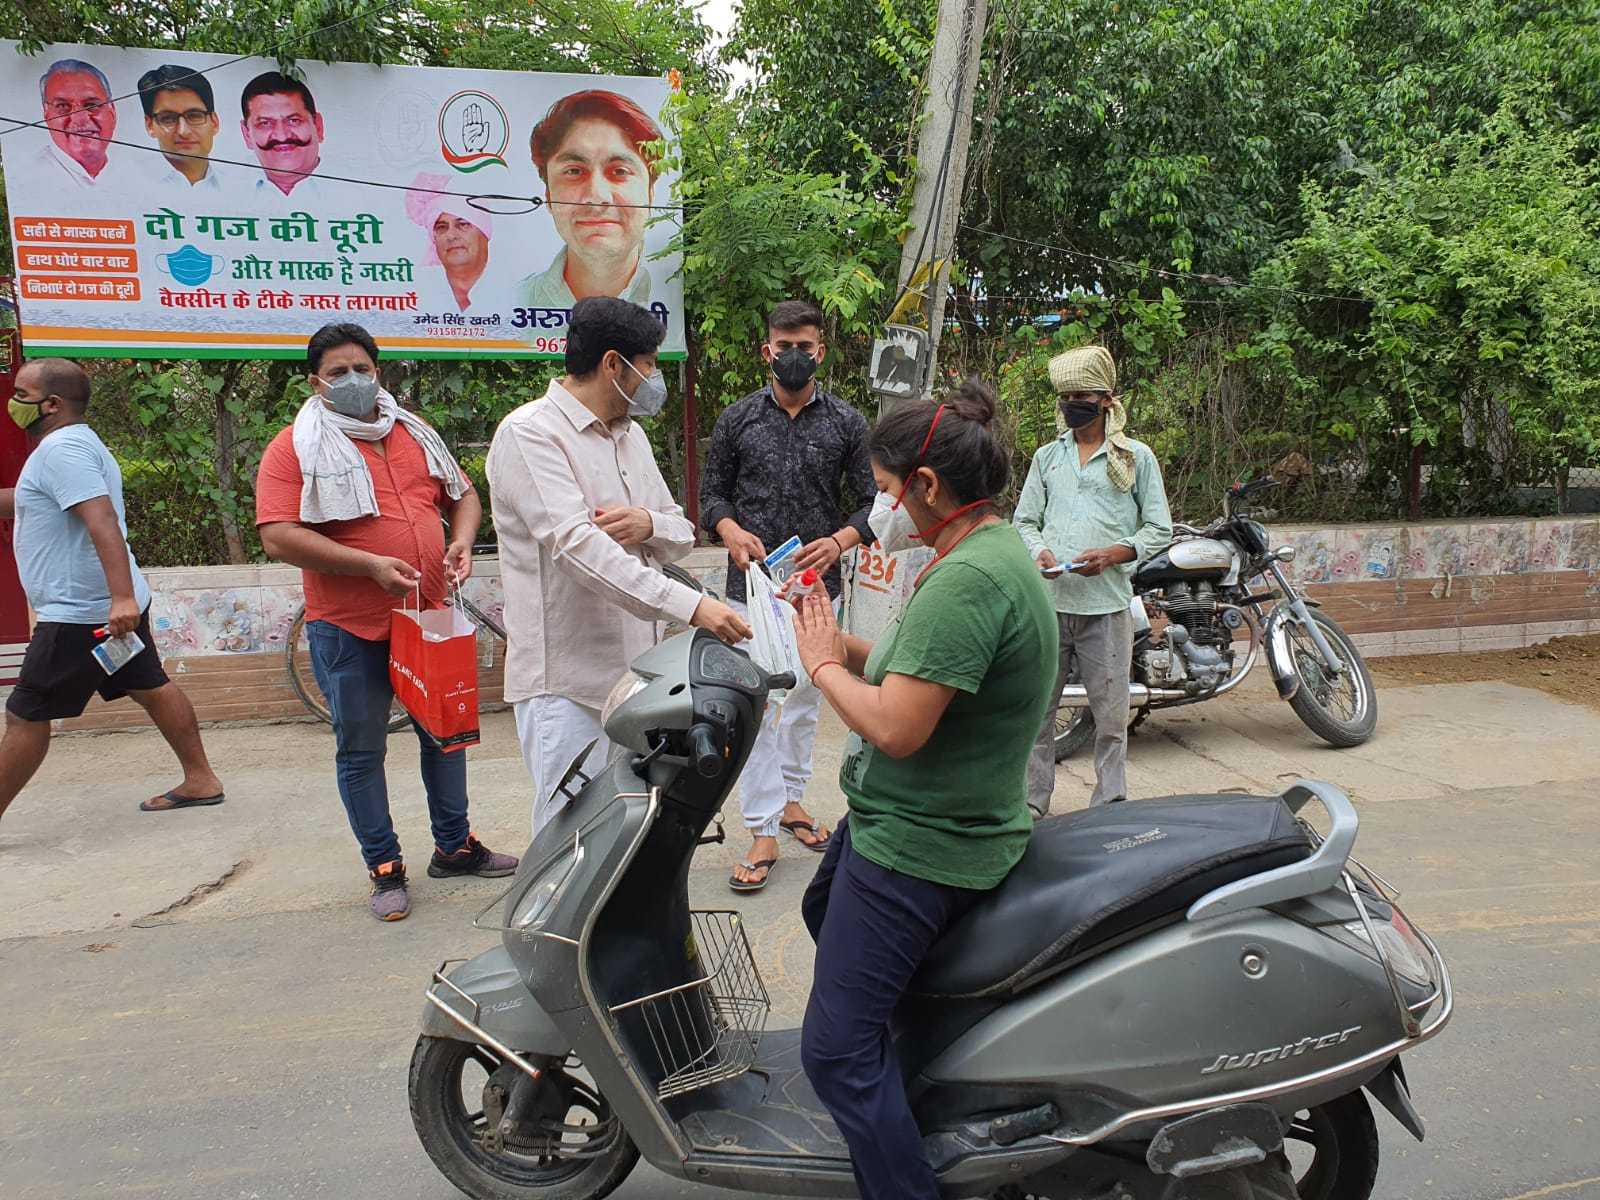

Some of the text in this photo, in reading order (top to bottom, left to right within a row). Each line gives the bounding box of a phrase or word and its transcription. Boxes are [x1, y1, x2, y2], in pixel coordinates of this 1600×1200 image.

[21, 222, 46, 238] सही
[48, 223, 61, 238] से
[63, 226, 97, 239] मास्क
[143, 207, 384, 253] दो गज की दूरी
[25, 253, 52, 266] हाथ
[231, 254, 272, 280] और
[278, 260, 334, 281] मास्क
[338, 256, 354, 285] है
[65, 280, 77, 295] दो
[79, 283, 97, 295] गज
[98, 281, 114, 296] की
[116, 282, 135, 299] दूरी
[159, 287, 227, 309] वैक्सीन
[232, 289, 251, 309] के
[256, 289, 294, 310] टीके
[412, 313, 501, 326] उमेद सिंह खतरी
[1201, 1025, 1362, 1075] Jupiter
